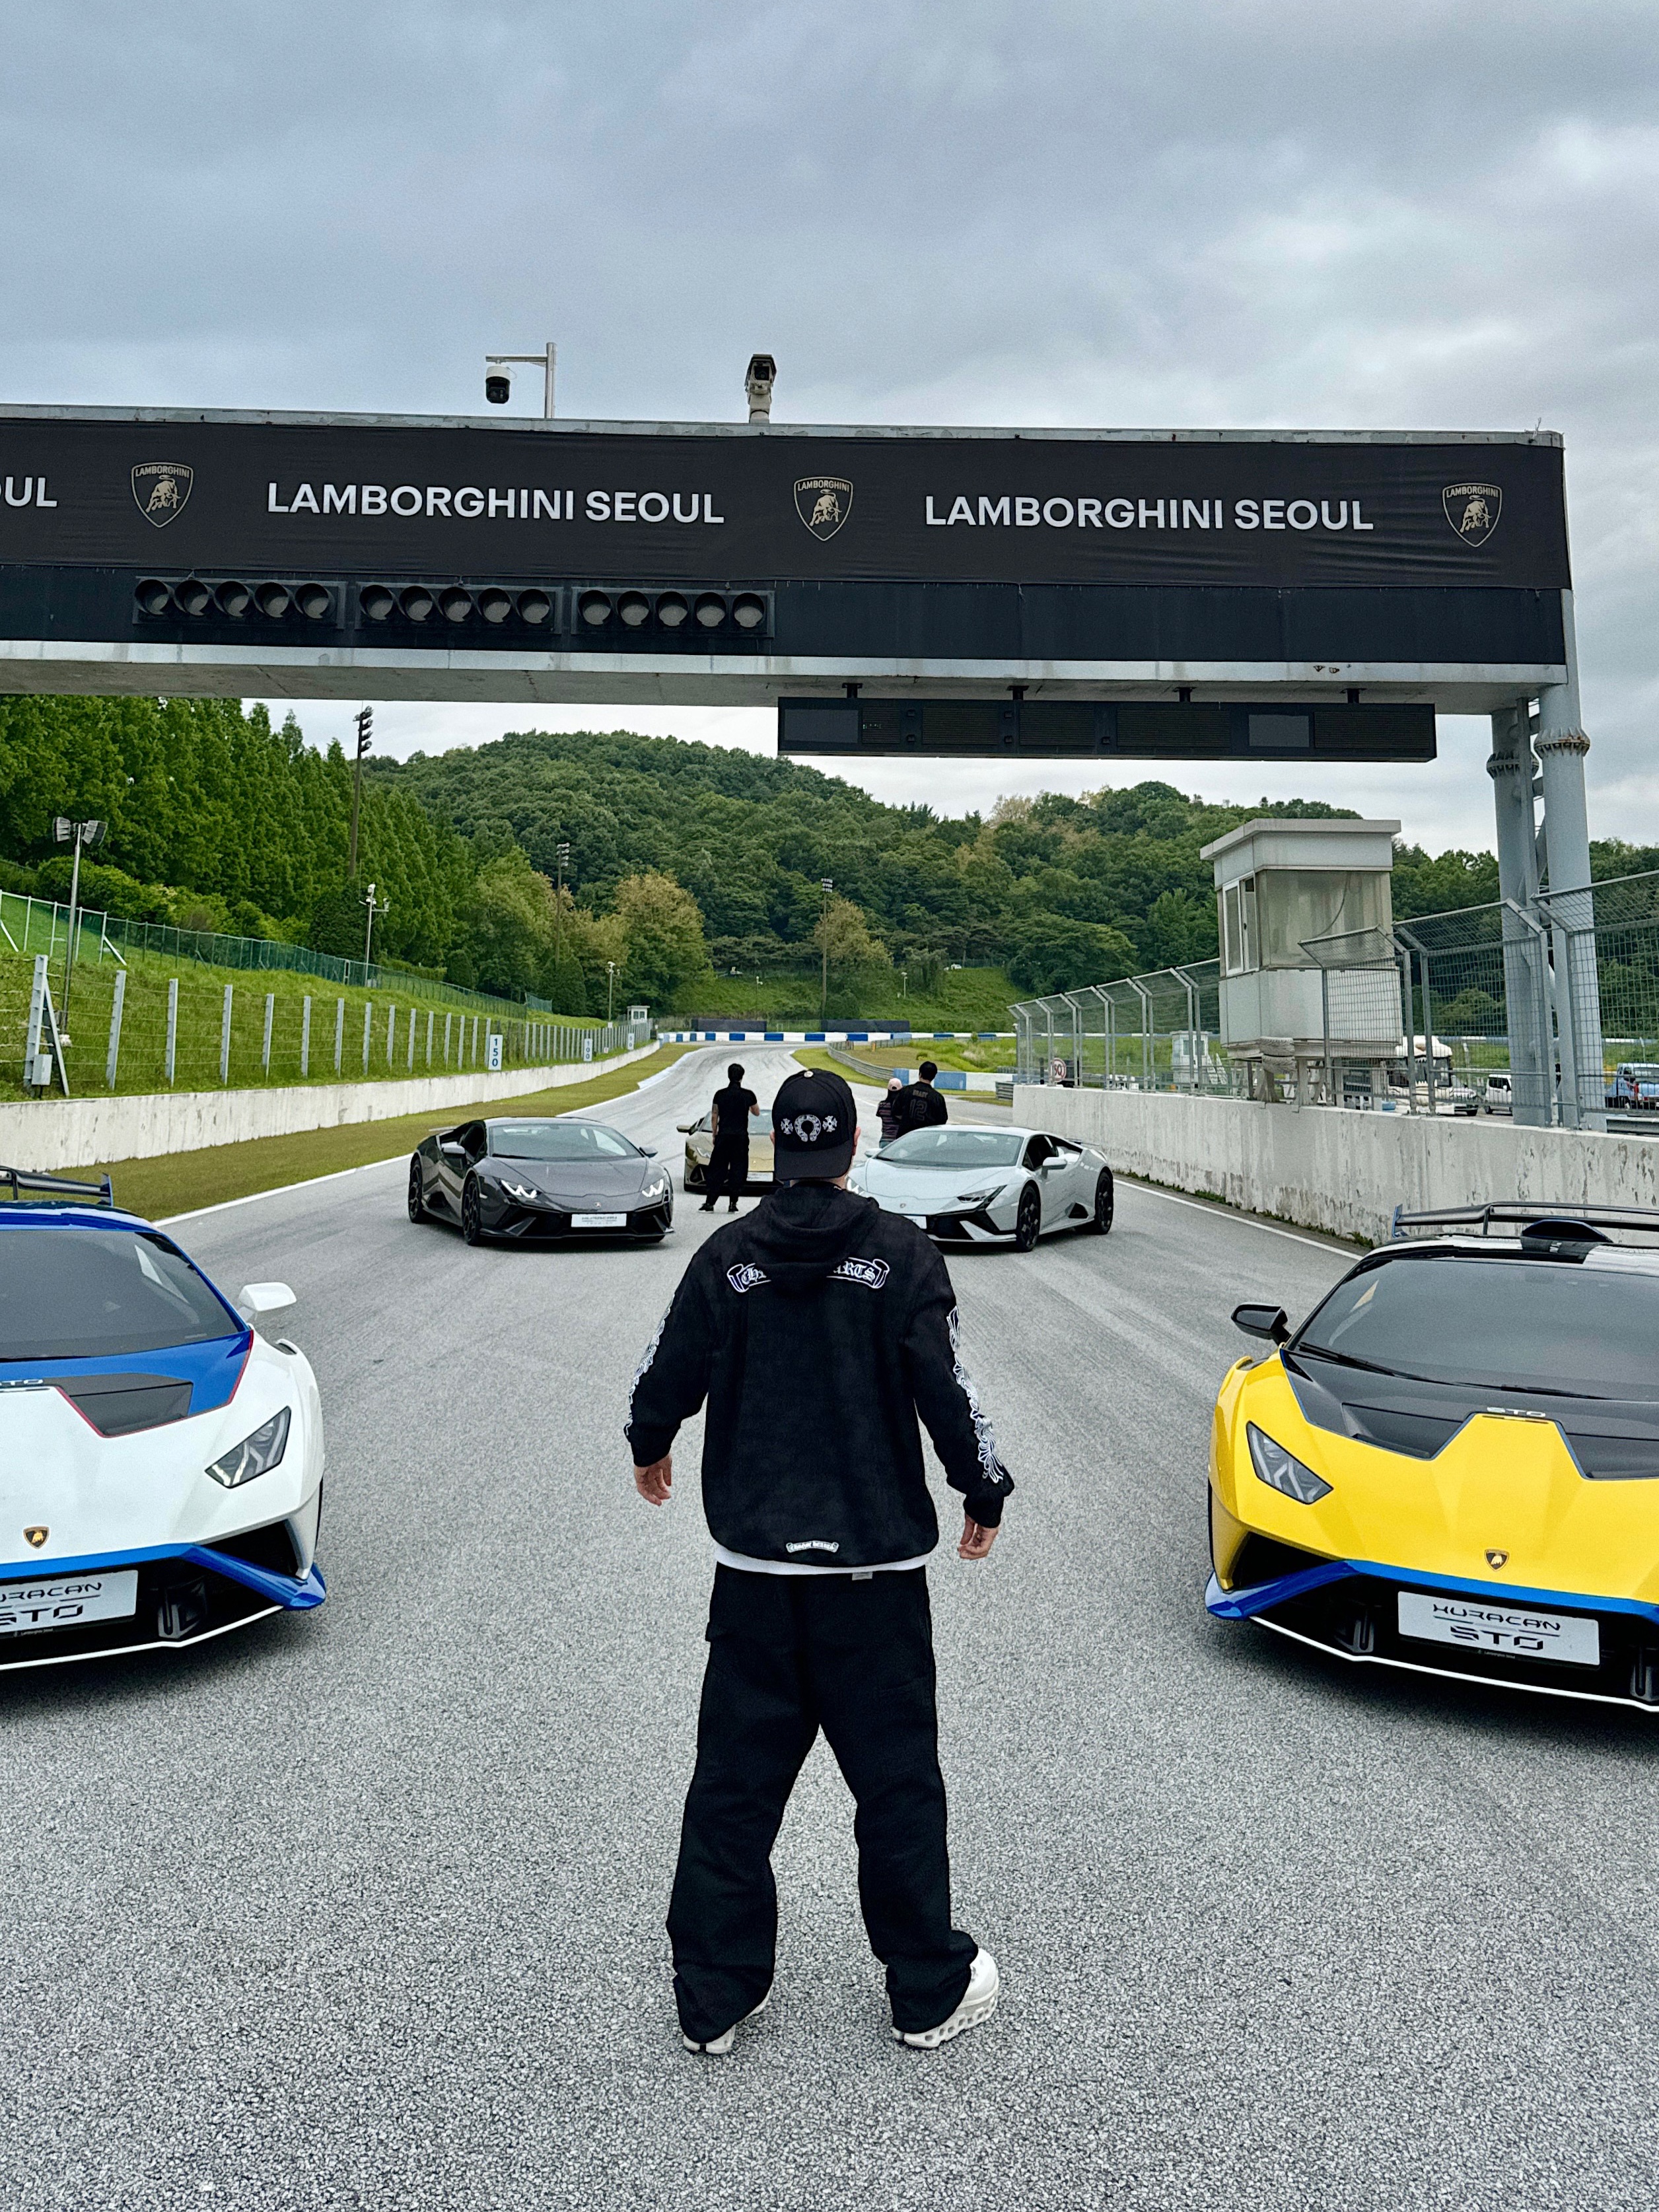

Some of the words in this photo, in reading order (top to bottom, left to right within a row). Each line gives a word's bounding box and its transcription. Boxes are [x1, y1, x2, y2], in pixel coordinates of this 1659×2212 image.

[135, 466, 190, 478] LAMBORGHINI
[0, 477, 57, 507] UL
[797, 479, 849, 493] LAMBORGHINI
[1446, 485, 1499, 499] LAMBORGHINI
[268, 483, 574, 520] LAMBORGHINI
[585, 491, 724, 524] SEOUL
[926, 496, 1223, 529] LAMBORGHINI
[1234, 499, 1374, 530] SEOUL
[909, 1099, 927, 1121] 12
[1487, 1407, 1545, 1417] STO
[1450, 1625, 1543, 1651] STO
